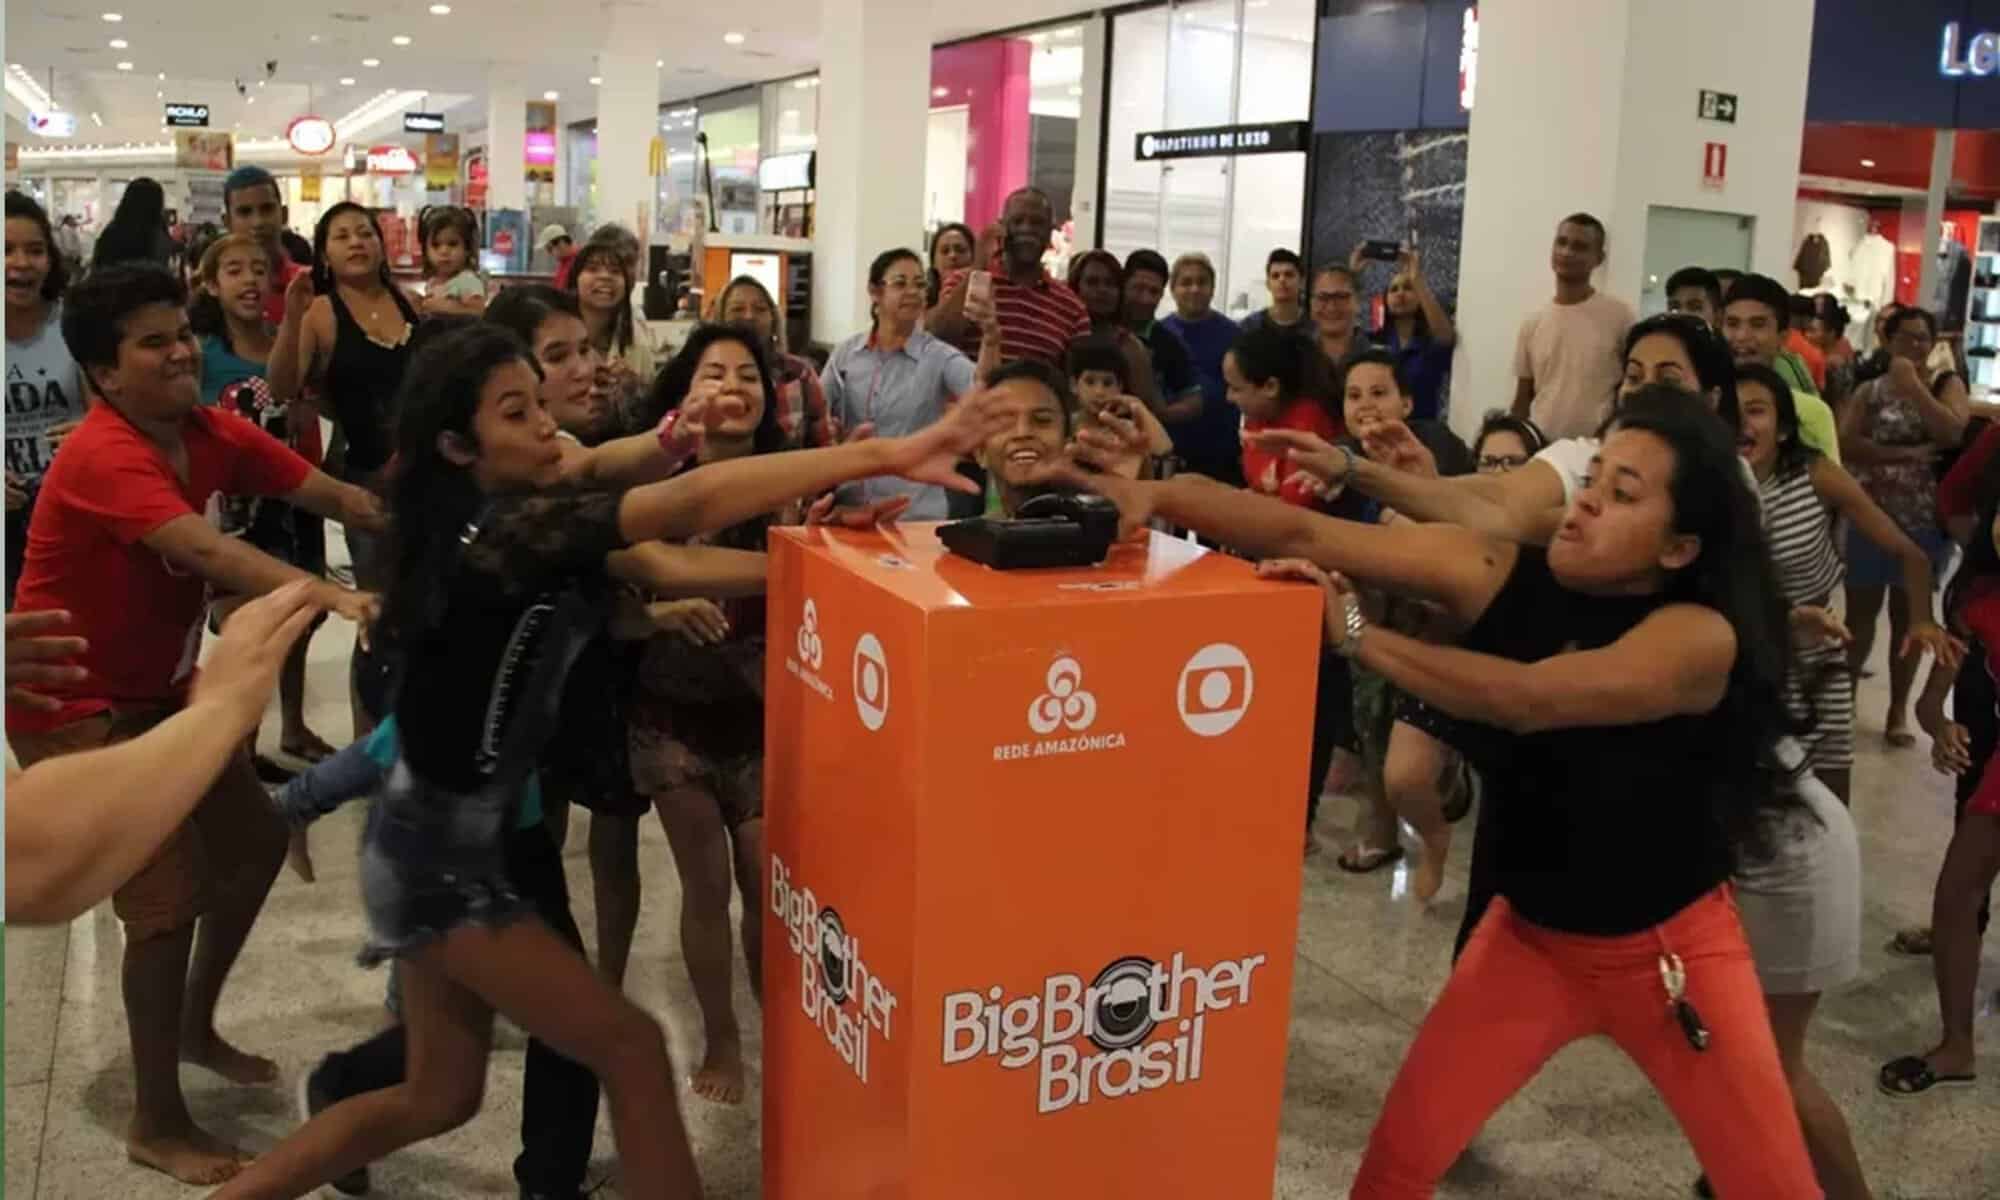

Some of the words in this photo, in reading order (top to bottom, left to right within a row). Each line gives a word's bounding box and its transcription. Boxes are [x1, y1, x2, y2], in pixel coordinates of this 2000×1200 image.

[1219, 133, 1234, 148] DE
[1237, 131, 1270, 146] LUXO
[993, 742, 1031, 760] REDE
[1033, 731, 1126, 758] AMAZÔNICA
[801, 950, 869, 1084] Brasil
[1037, 1013, 1206, 1114] Brasil
